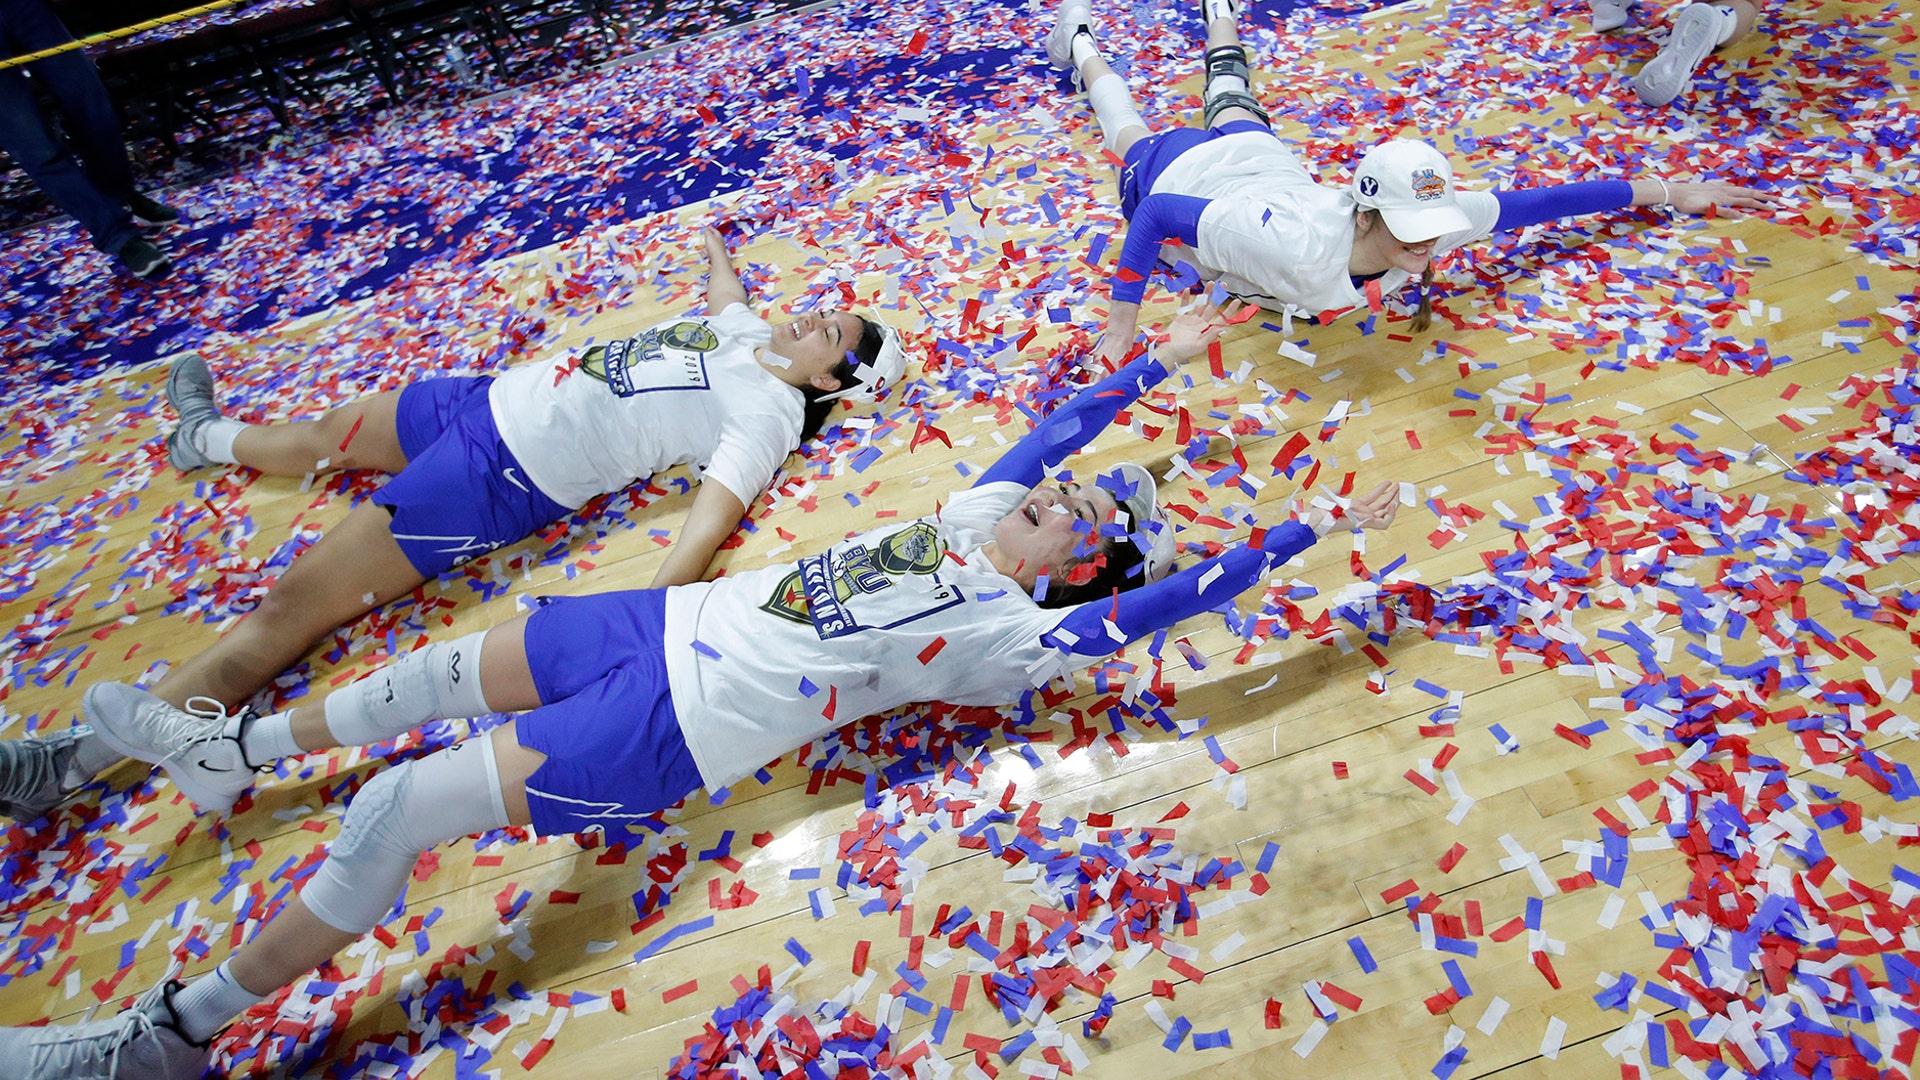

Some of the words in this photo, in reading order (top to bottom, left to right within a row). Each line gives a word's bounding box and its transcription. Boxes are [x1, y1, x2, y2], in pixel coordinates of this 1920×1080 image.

[1362, 177, 1378, 196] Y
[684, 355, 701, 382] 2019
[841, 543, 892, 594] BYU
[802, 558, 844, 632] AMPIONS
